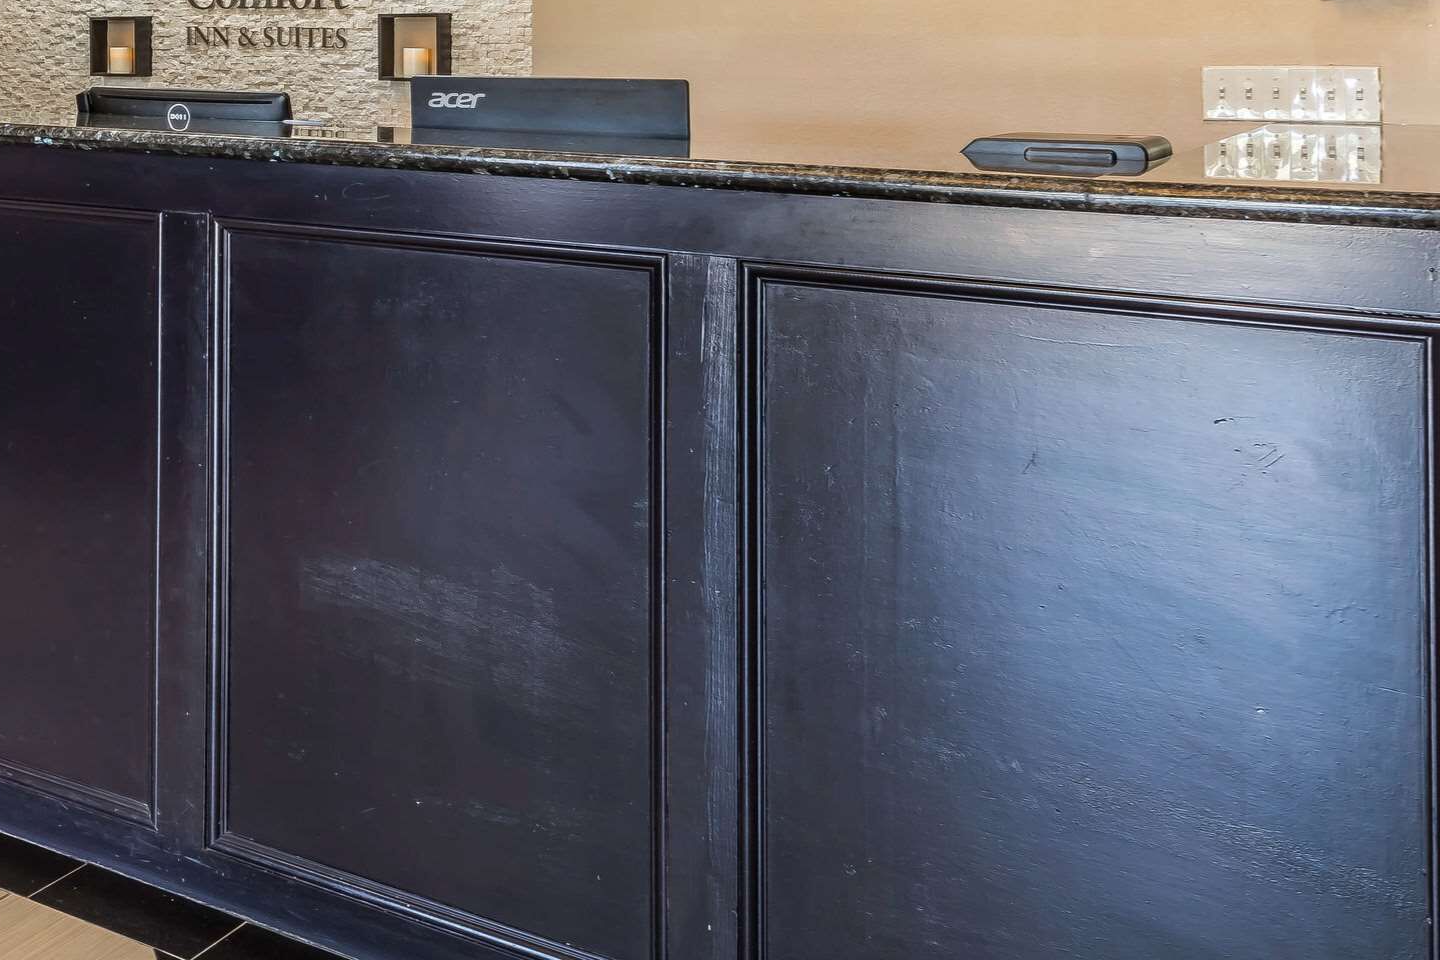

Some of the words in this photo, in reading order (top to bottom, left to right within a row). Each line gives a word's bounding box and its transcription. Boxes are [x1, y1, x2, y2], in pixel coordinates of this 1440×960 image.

[186, 26, 231, 48] INN
[238, 26, 258, 47] &
[263, 27, 347, 49] SUITES
[428, 92, 486, 108] acer
